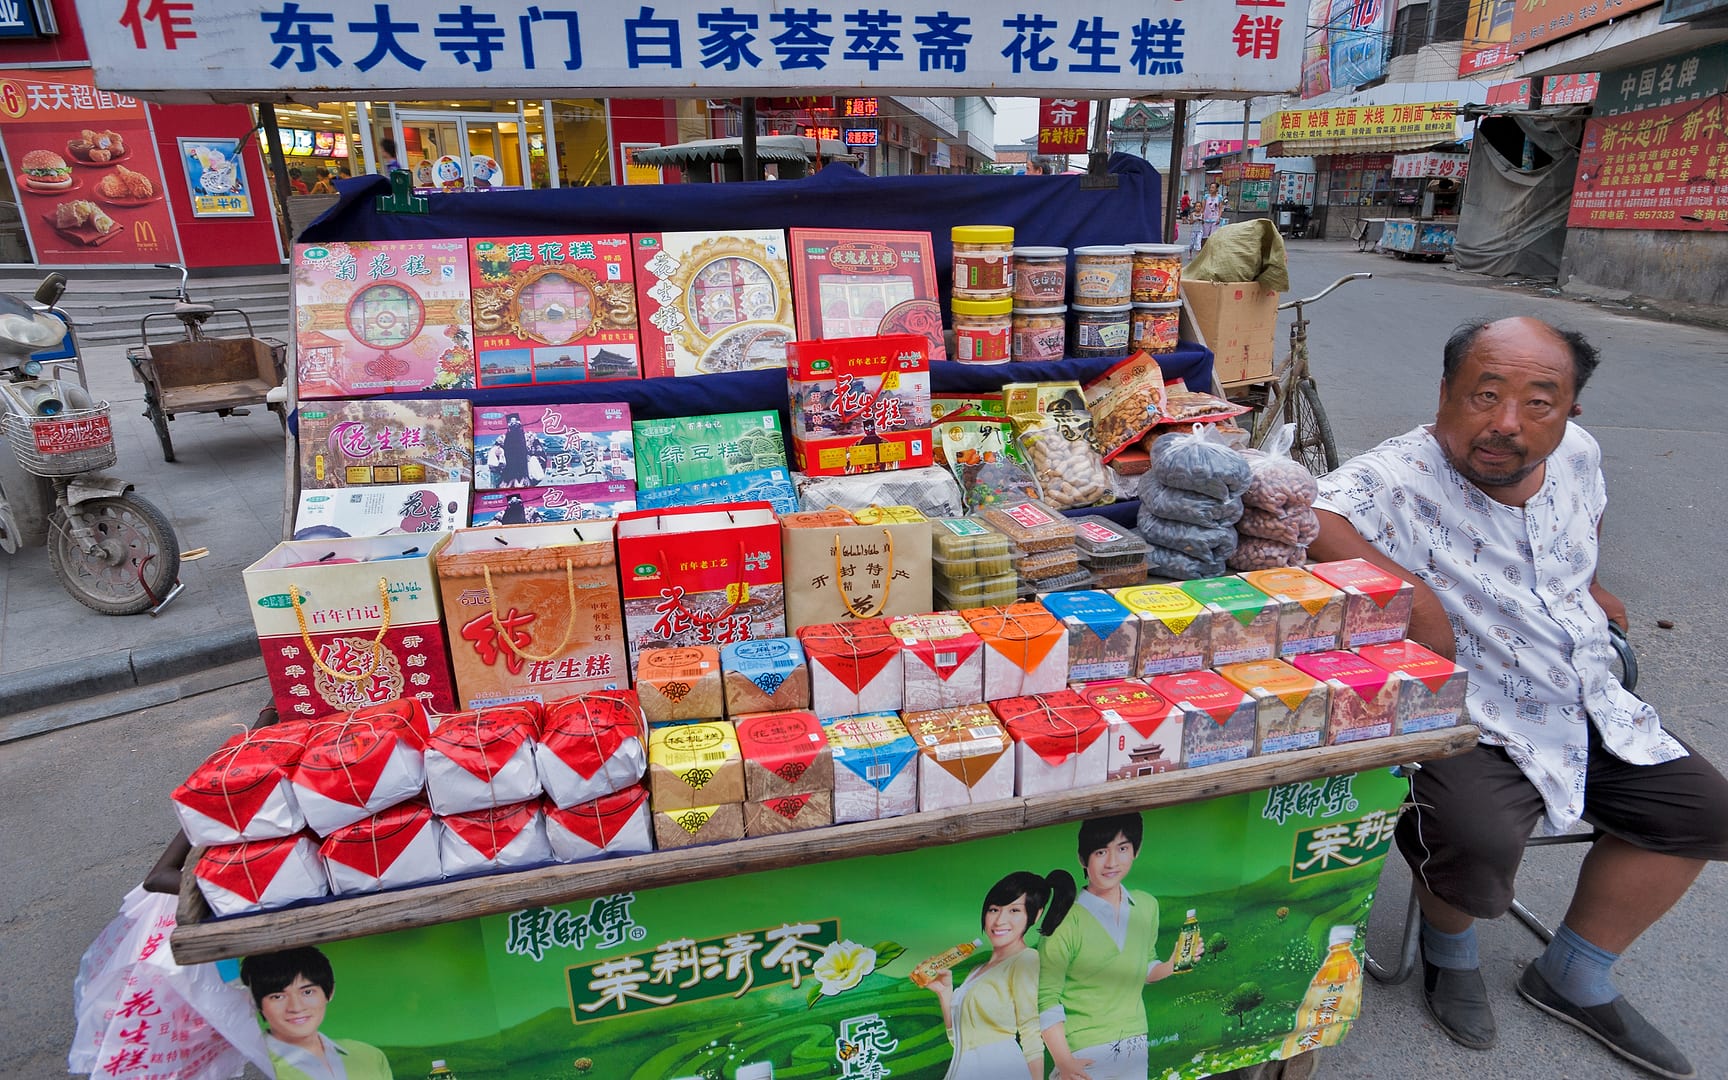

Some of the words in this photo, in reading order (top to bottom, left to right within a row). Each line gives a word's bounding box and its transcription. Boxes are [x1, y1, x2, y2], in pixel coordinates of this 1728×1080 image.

[260, 3, 582, 72] 东大寺门
[625, 6, 972, 73] 白家荟萃斋
[1001, 14, 1186, 76] 花生糕
[1232, 0, 1287, 60] 销
[1621, 57, 1699, 100] 中国名牌
[27, 85, 137, 110] 天天超值选
[853, 101, 876, 114] 超市
[1336, 109, 1357, 126] 拉面
[1363, 108, 1384, 125] 米线
[1392, 105, 1425, 123] 刀削面
[1600, 114, 1673, 151] 新华超市
[1680, 105, 1728, 141] 新华
[1040, 127, 1086, 144] 开封特产
[217, 197, 241, 208] 半价
[1633, 210, 1675, 219] 5957333
[507, 241, 596, 262] 桂花糕
[336, 253, 432, 281] 菊花糕
[831, 373, 906, 431] 花生糕
[346, 423, 426, 451] 花生糕
[551, 451, 602, 478] 黑豆
[660, 441, 740, 464] 绿豆糕
[680, 558, 728, 571] 百年老工艺
[812, 562, 911, 590] 开封特产
[312, 605, 382, 625] 百年白记
[281, 645, 315, 715] 中华名吃
[528, 654, 612, 684] 花生糕
[1296, 807, 1399, 870] 茉莉
[506, 893, 634, 960] 康師傅
[578, 922, 828, 1014] 茉莉清茶
[103, 989, 162, 1077] 花生糕
